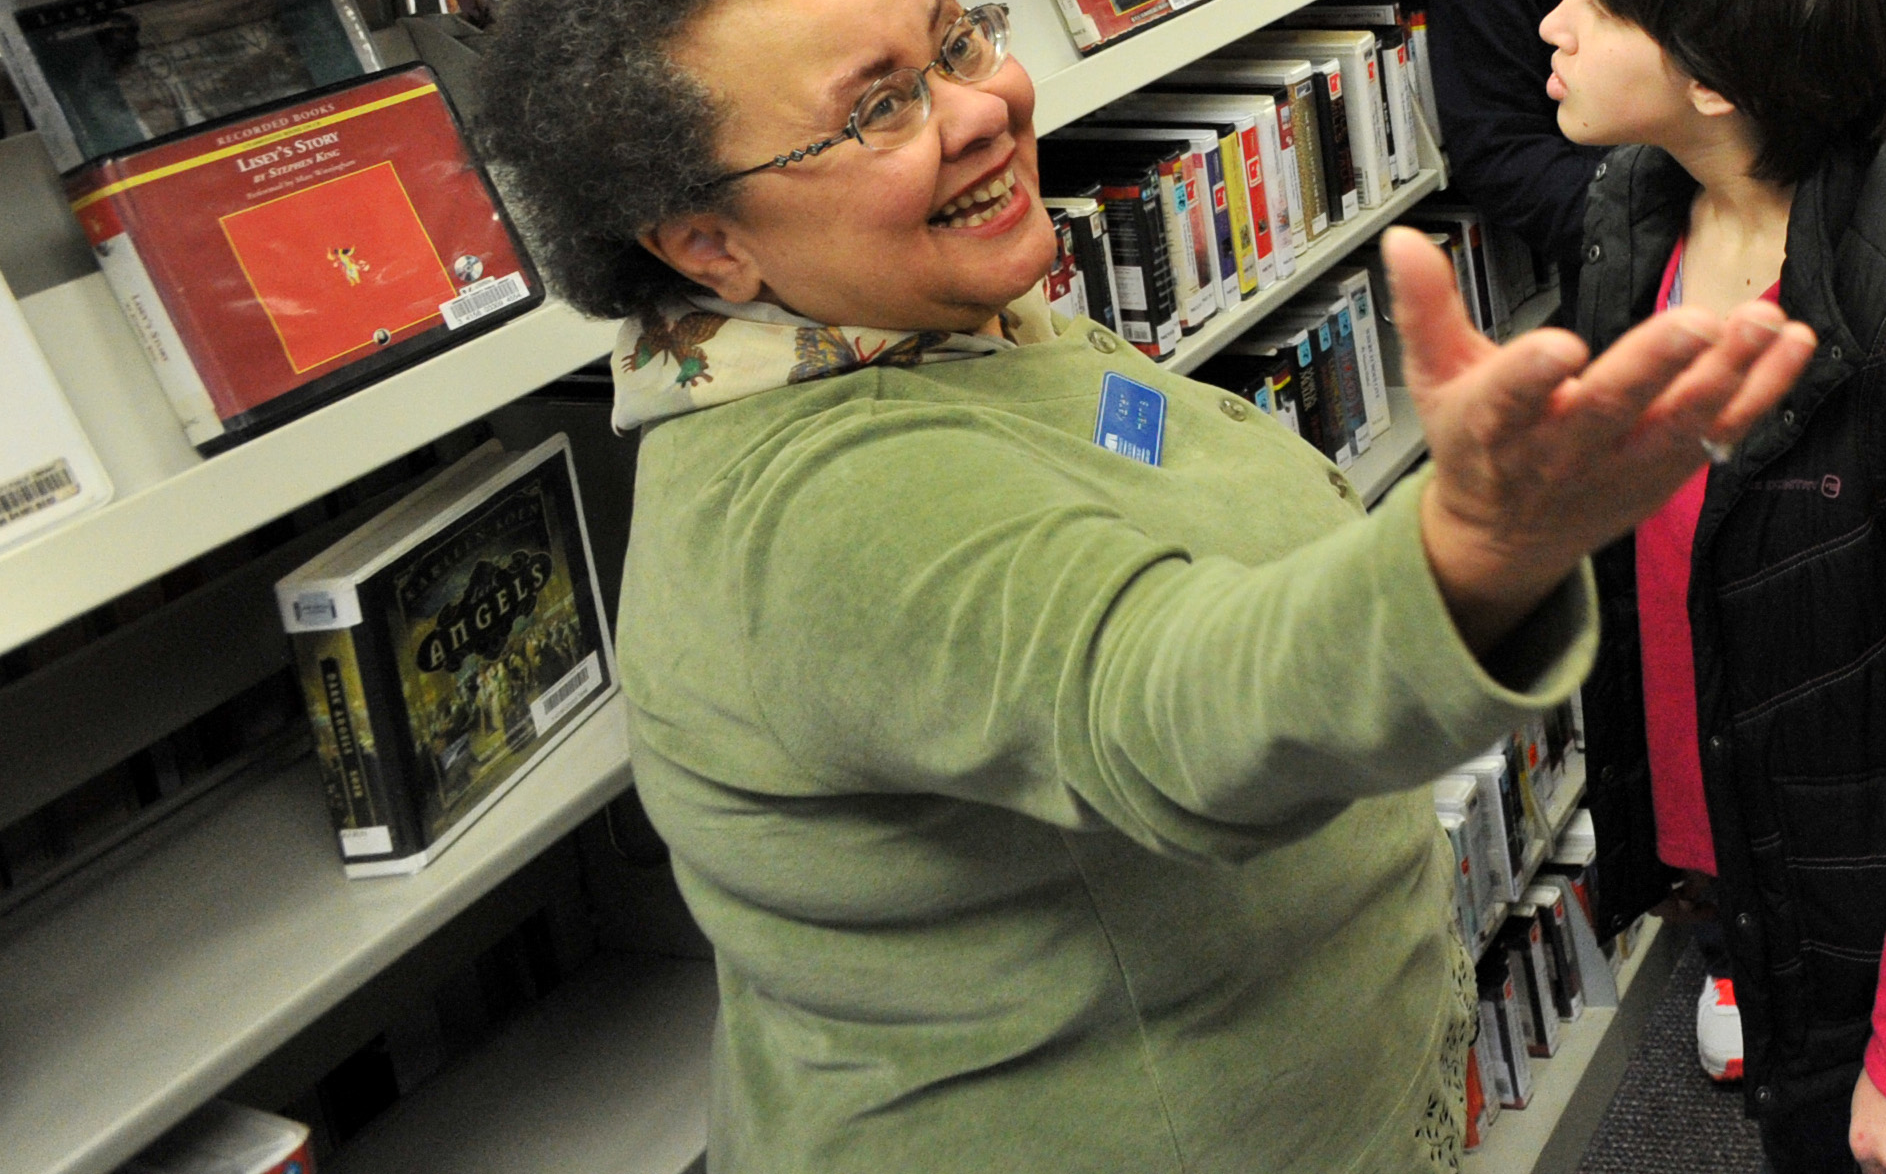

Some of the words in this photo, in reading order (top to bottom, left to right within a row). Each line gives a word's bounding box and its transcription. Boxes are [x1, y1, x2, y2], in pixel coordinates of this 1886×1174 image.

[215, 117, 290, 147] RECORDED
[292, 103, 336, 123] BOOKS
[236, 145, 294, 173] LISEY'S
[294, 131, 341, 154] STORY
[268, 157, 314, 178] STEPHEN
[315, 148, 341, 164] KING
[429, 562, 545, 669] ANGELS
